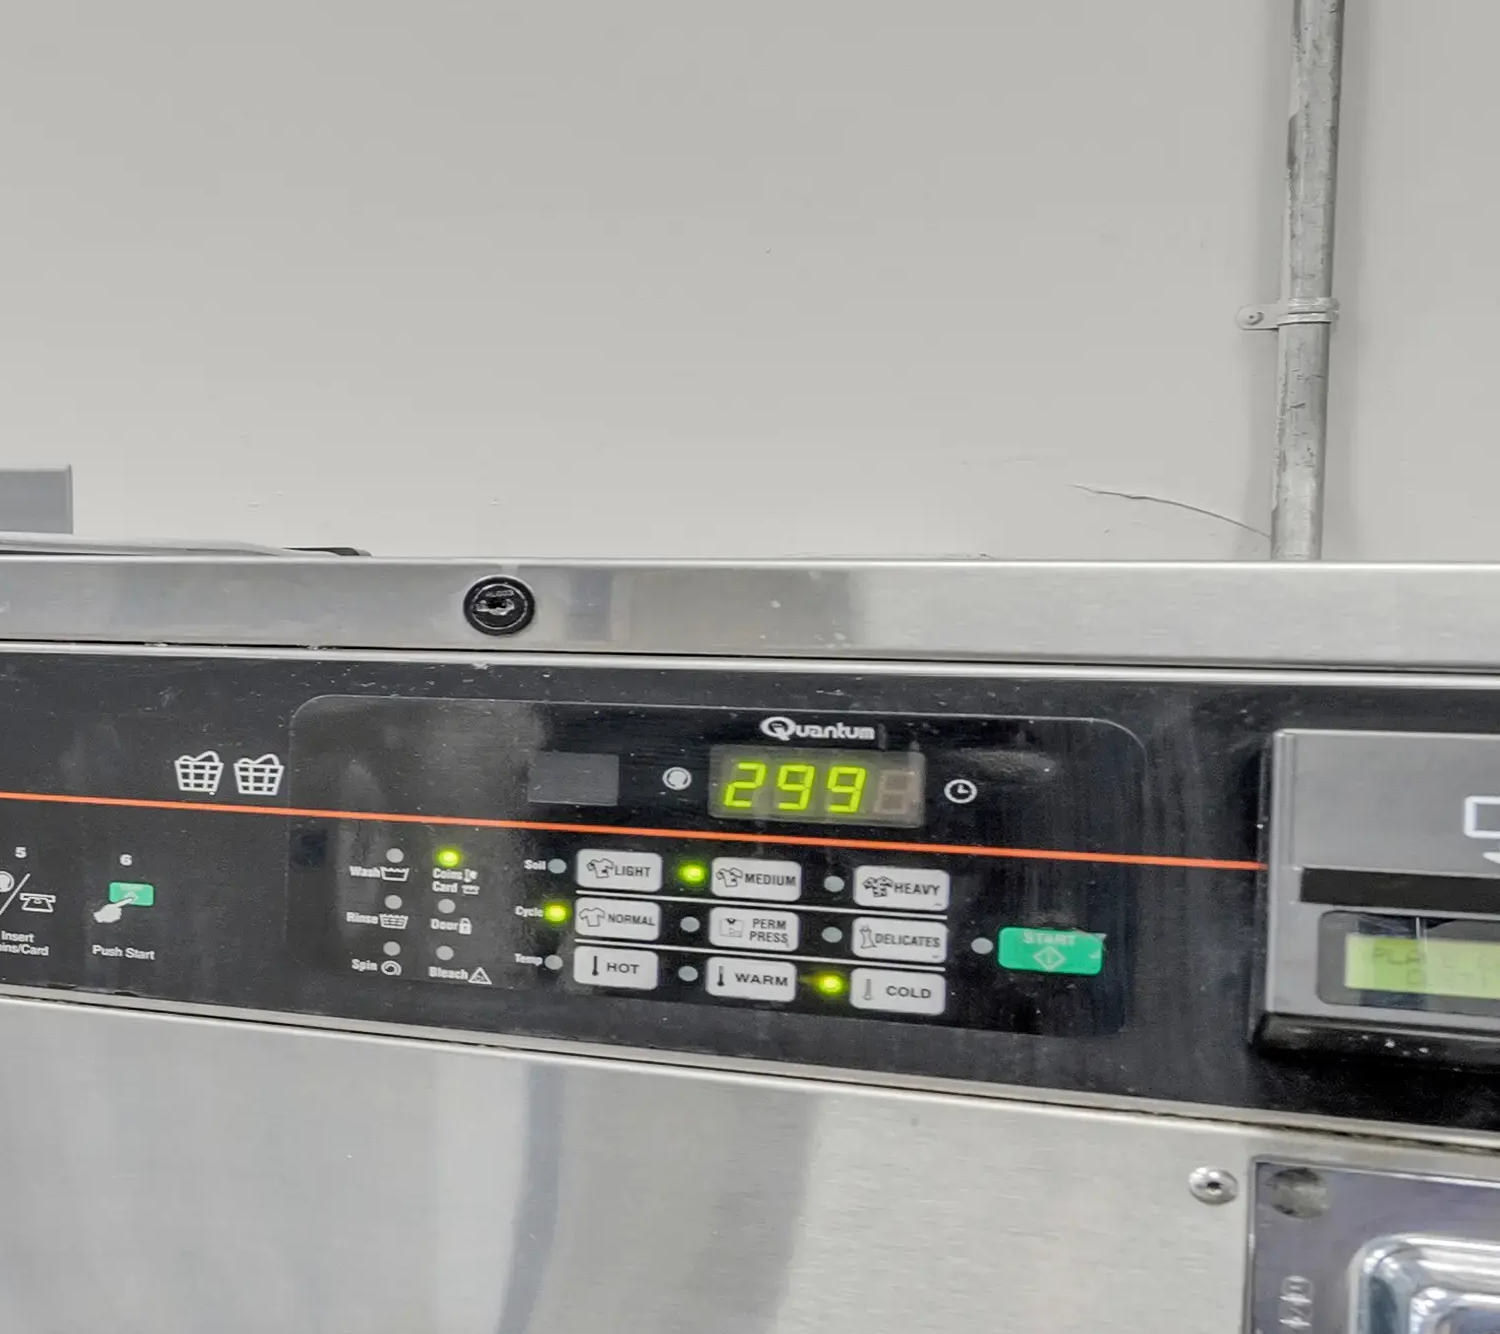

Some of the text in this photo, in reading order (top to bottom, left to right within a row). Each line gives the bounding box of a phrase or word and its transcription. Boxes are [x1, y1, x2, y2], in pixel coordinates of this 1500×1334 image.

[760, 716, 875, 742] Quantum
[724, 761, 867, 814] 299
[15, 847, 26, 858] 5
[120, 854, 132, 865] 6
[524, 859, 546, 871] Soil
[350, 866, 380, 879] Wash
[432, 868, 463, 880] Coins
[614, 865, 651, 877] LIGHT
[745, 873, 796, 887] MEDIUM
[432, 881, 458, 893] Card
[893, 882, 940, 896] HEAVY
[346, 911, 378, 925] Rinse
[515, 906, 543, 918] Cycle
[431, 919, 458, 930] Door
[608, 913, 655, 927] NORMAL
[752, 918, 787, 931] PERM
[1, 931, 34, 943] Insert
[750, 931, 788, 944] PRESS
[875, 933, 941, 948] DELICATES
[92, 944, 155, 961] Push Start
[352, 959, 378, 971] Spin
[514, 953, 543, 966] Temp
[429, 966, 468, 981] Bleach
[606, 961, 640, 974] HOT
[735, 972, 788, 987] WARM
[886, 985, 932, 999] COLD
